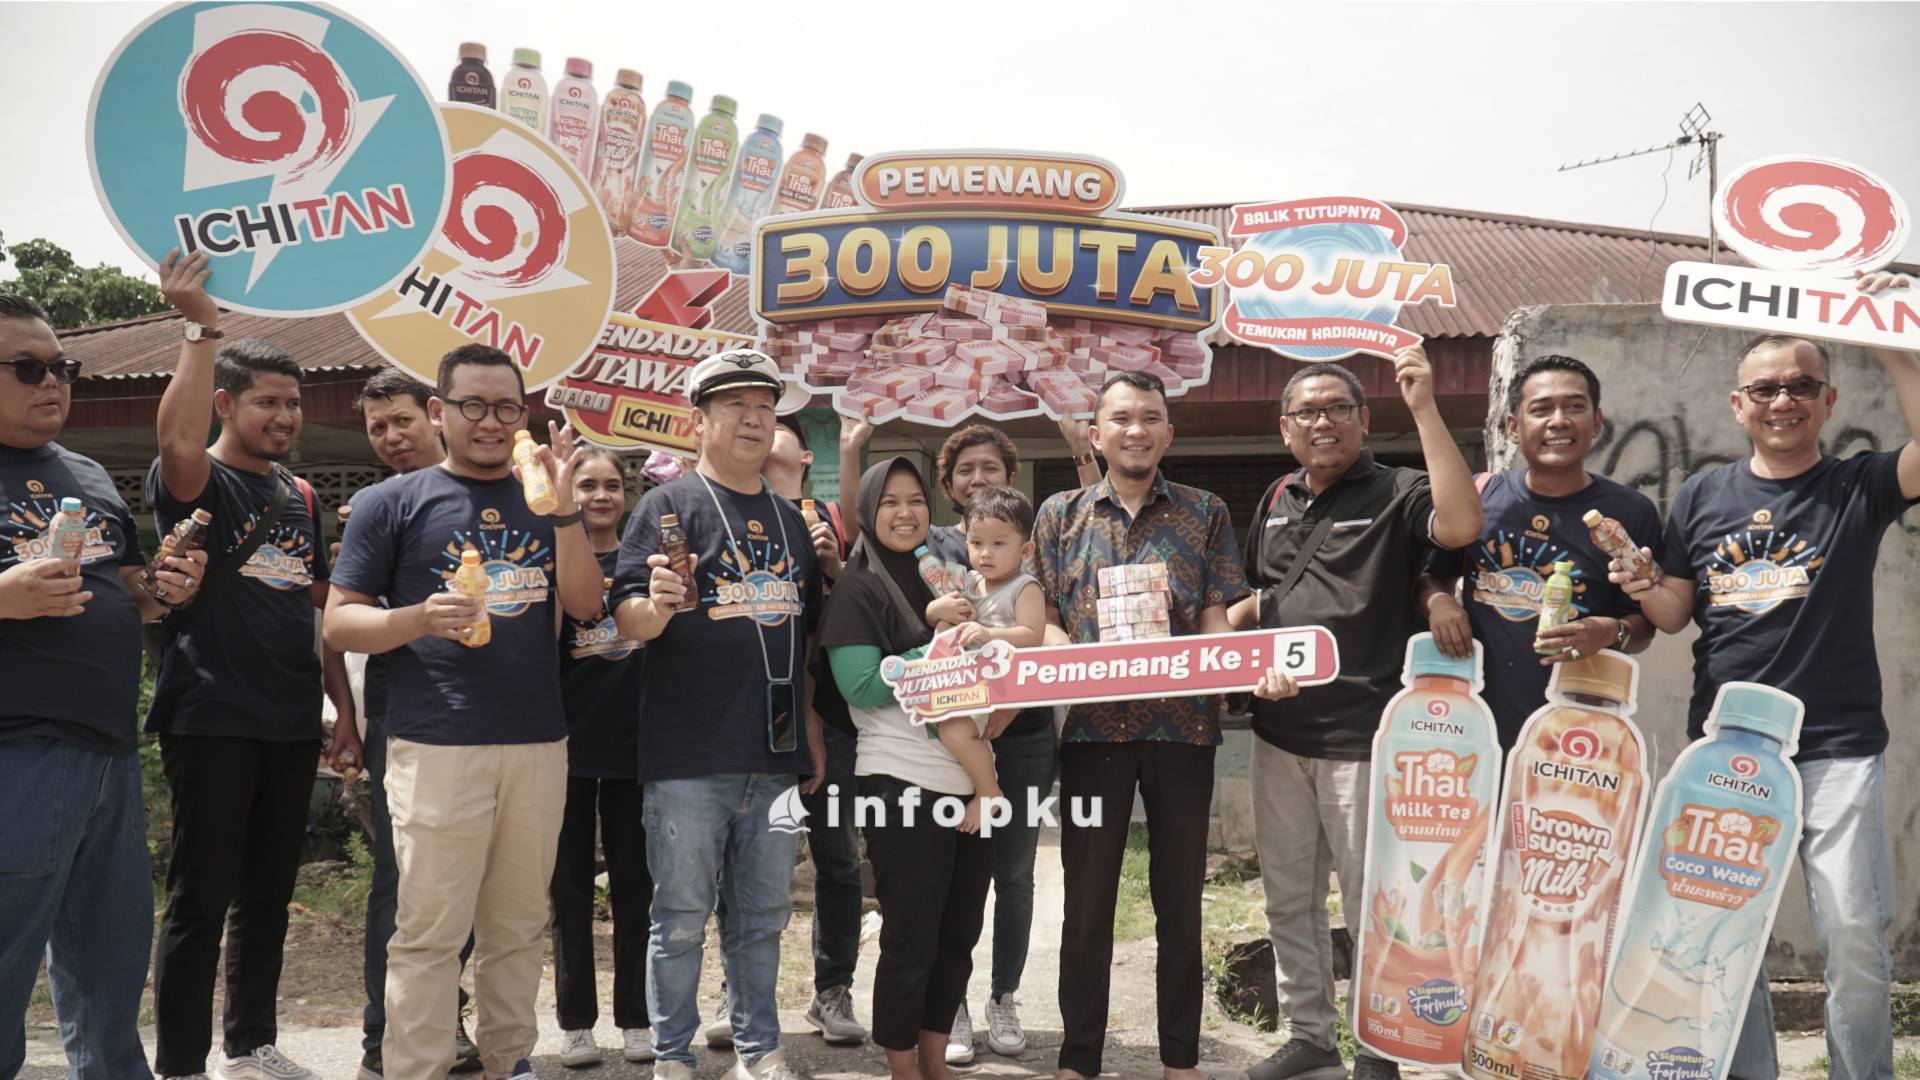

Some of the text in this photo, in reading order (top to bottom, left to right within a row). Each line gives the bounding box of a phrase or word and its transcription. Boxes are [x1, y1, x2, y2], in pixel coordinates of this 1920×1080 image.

[456, 85, 488, 96] ICHITAN
[508, 90, 540, 100] ICHITAN
[559, 98, 590, 110] ICHITAN
[608, 108, 638, 120] ICHITAN
[607, 126, 637, 141] brown
[656, 124, 684, 146] Thai
[702, 138, 727, 158] Thai
[747, 156, 771, 176] Thai
[789, 173, 812, 195] Thai
[878, 165, 1101, 201] PEMENANG
[179, 187, 411, 254] ICHITAN
[1243, 204, 1381, 226] BALIK TUTUPNYA
[777, 225, 1200, 313] 300 JUTA
[1190, 248, 1456, 305] 300 JUTA
[398, 266, 541, 368] HITAN
[598, 324, 748, 361] ENDADAK
[1236, 322, 1398, 347] TEMUKAN HADIAHNYA
[554, 389, 604, 408] DARI
[1524, 530, 1549, 541] ICHITAN
[496, 569, 546, 588] JUTA
[1478, 572, 1545, 598] 300 JU
[1710, 568, 1806, 592] 300 JUTA
[718, 584, 756, 602] 300
[576, 629, 608, 645] 300
[904, 655, 978, 679] MENDADAK
[1017, 649, 1190, 686] Pemenang
[1199, 646, 1242, 672] Ke
[1285, 642, 1306, 669] 5
[897, 668, 978, 695] JUTAWAN
[936, 690, 980, 706] ICHITAN
[1410, 720, 1464, 736] ICHITAN
[1398, 755, 1467, 798] Thai
[1534, 761, 1618, 790] ICHITAN
[1708, 773, 1771, 799] ICHITAN
[1392, 802, 1471, 820] Milk Tea
[1399, 822, 1461, 837] ชานมไทย
[1530, 809, 1611, 848] brown
[1686, 808, 1760, 865] Thai
[1528, 833, 1598, 862] sugar
[1523, 857, 1589, 900] Milk
[1666, 857, 1762, 888] Coco Water
[1416, 985, 1459, 995] Signature
[1410, 992, 1465, 1016] Formula
[1660, 1052, 1708, 1064] Signature
[1648, 1061, 1710, 1080] Formula
